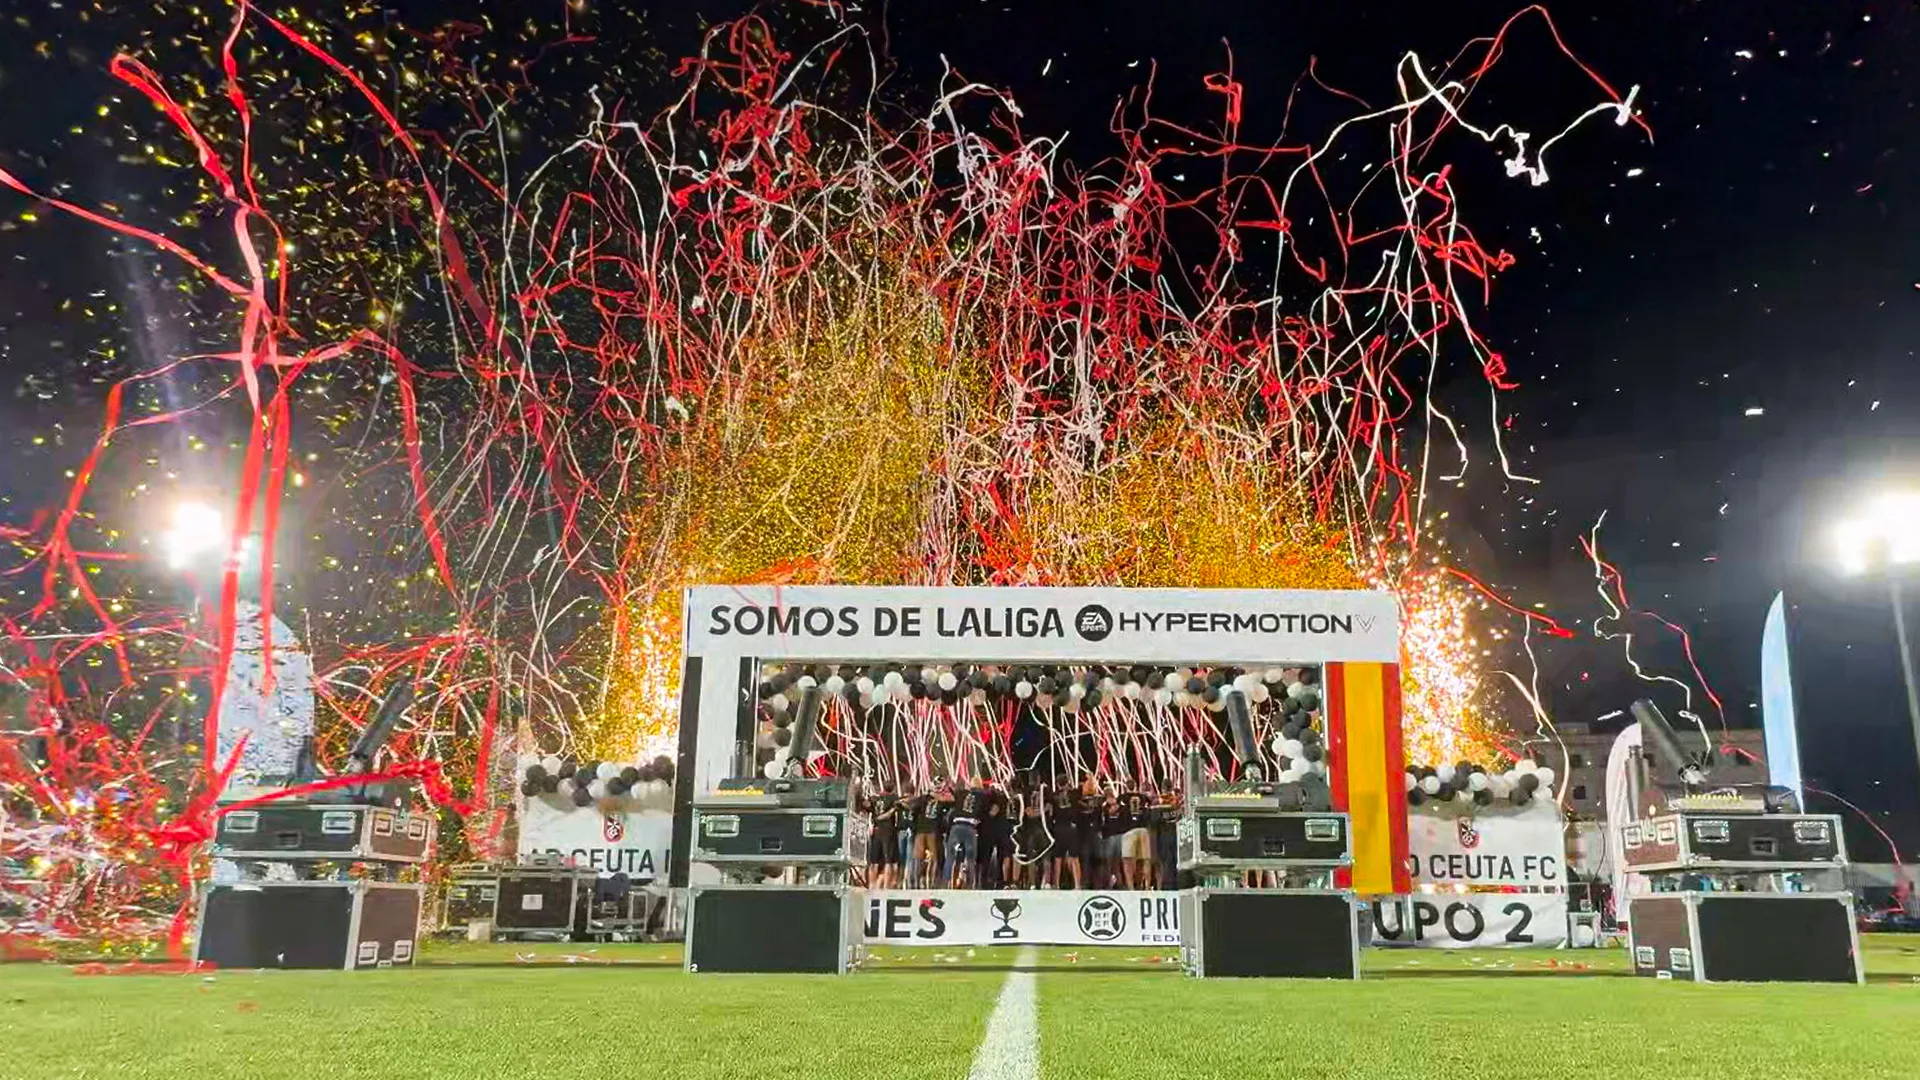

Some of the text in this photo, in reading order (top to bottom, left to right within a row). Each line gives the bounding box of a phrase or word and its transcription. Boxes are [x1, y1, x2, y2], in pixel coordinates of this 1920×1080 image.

[708, 605, 1065, 638] SOMOS DE LALIGA
[1082, 612, 1106, 625] EA
[1429, 854, 1515, 880] CEUTA
[1523, 855, 1556, 880] FC
[1502, 902, 1534, 943] 2
[1141, 934, 1180, 942] FED
